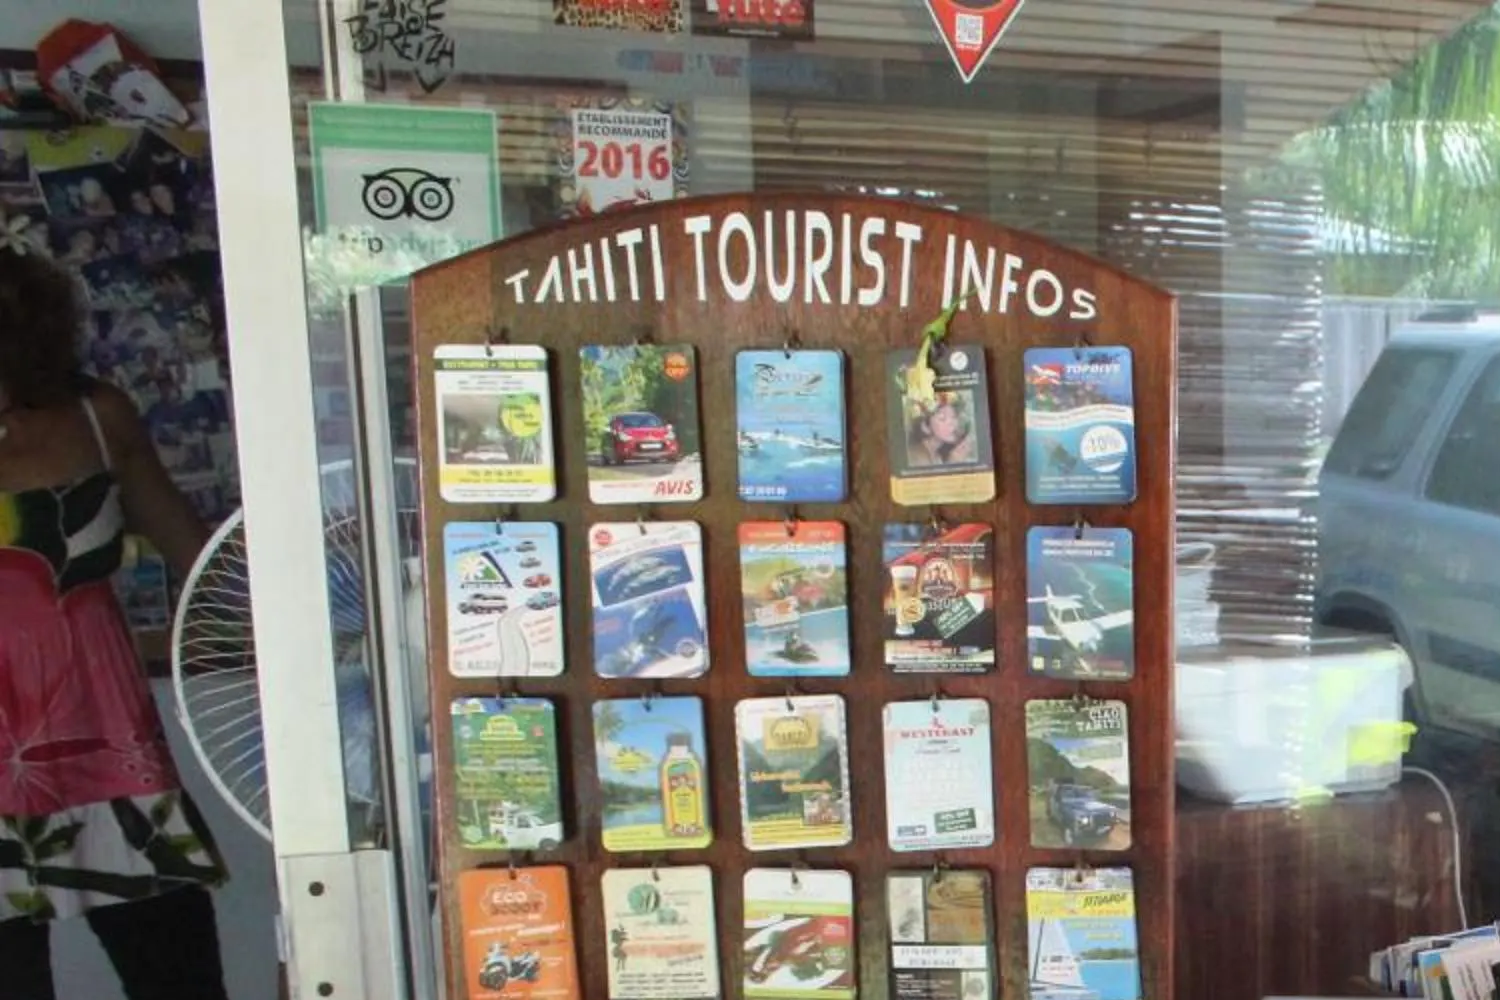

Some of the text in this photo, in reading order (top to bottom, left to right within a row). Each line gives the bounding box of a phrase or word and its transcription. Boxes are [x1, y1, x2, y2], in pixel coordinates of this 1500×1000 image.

[342, 14, 456, 69] BREIZH
[576, 140, 671, 181] 2016
[505, 209, 1097, 320] TAHITI TOURIST INFOS
[654, 479, 695, 496] AVIS
[492, 890, 528, 904] ECO
